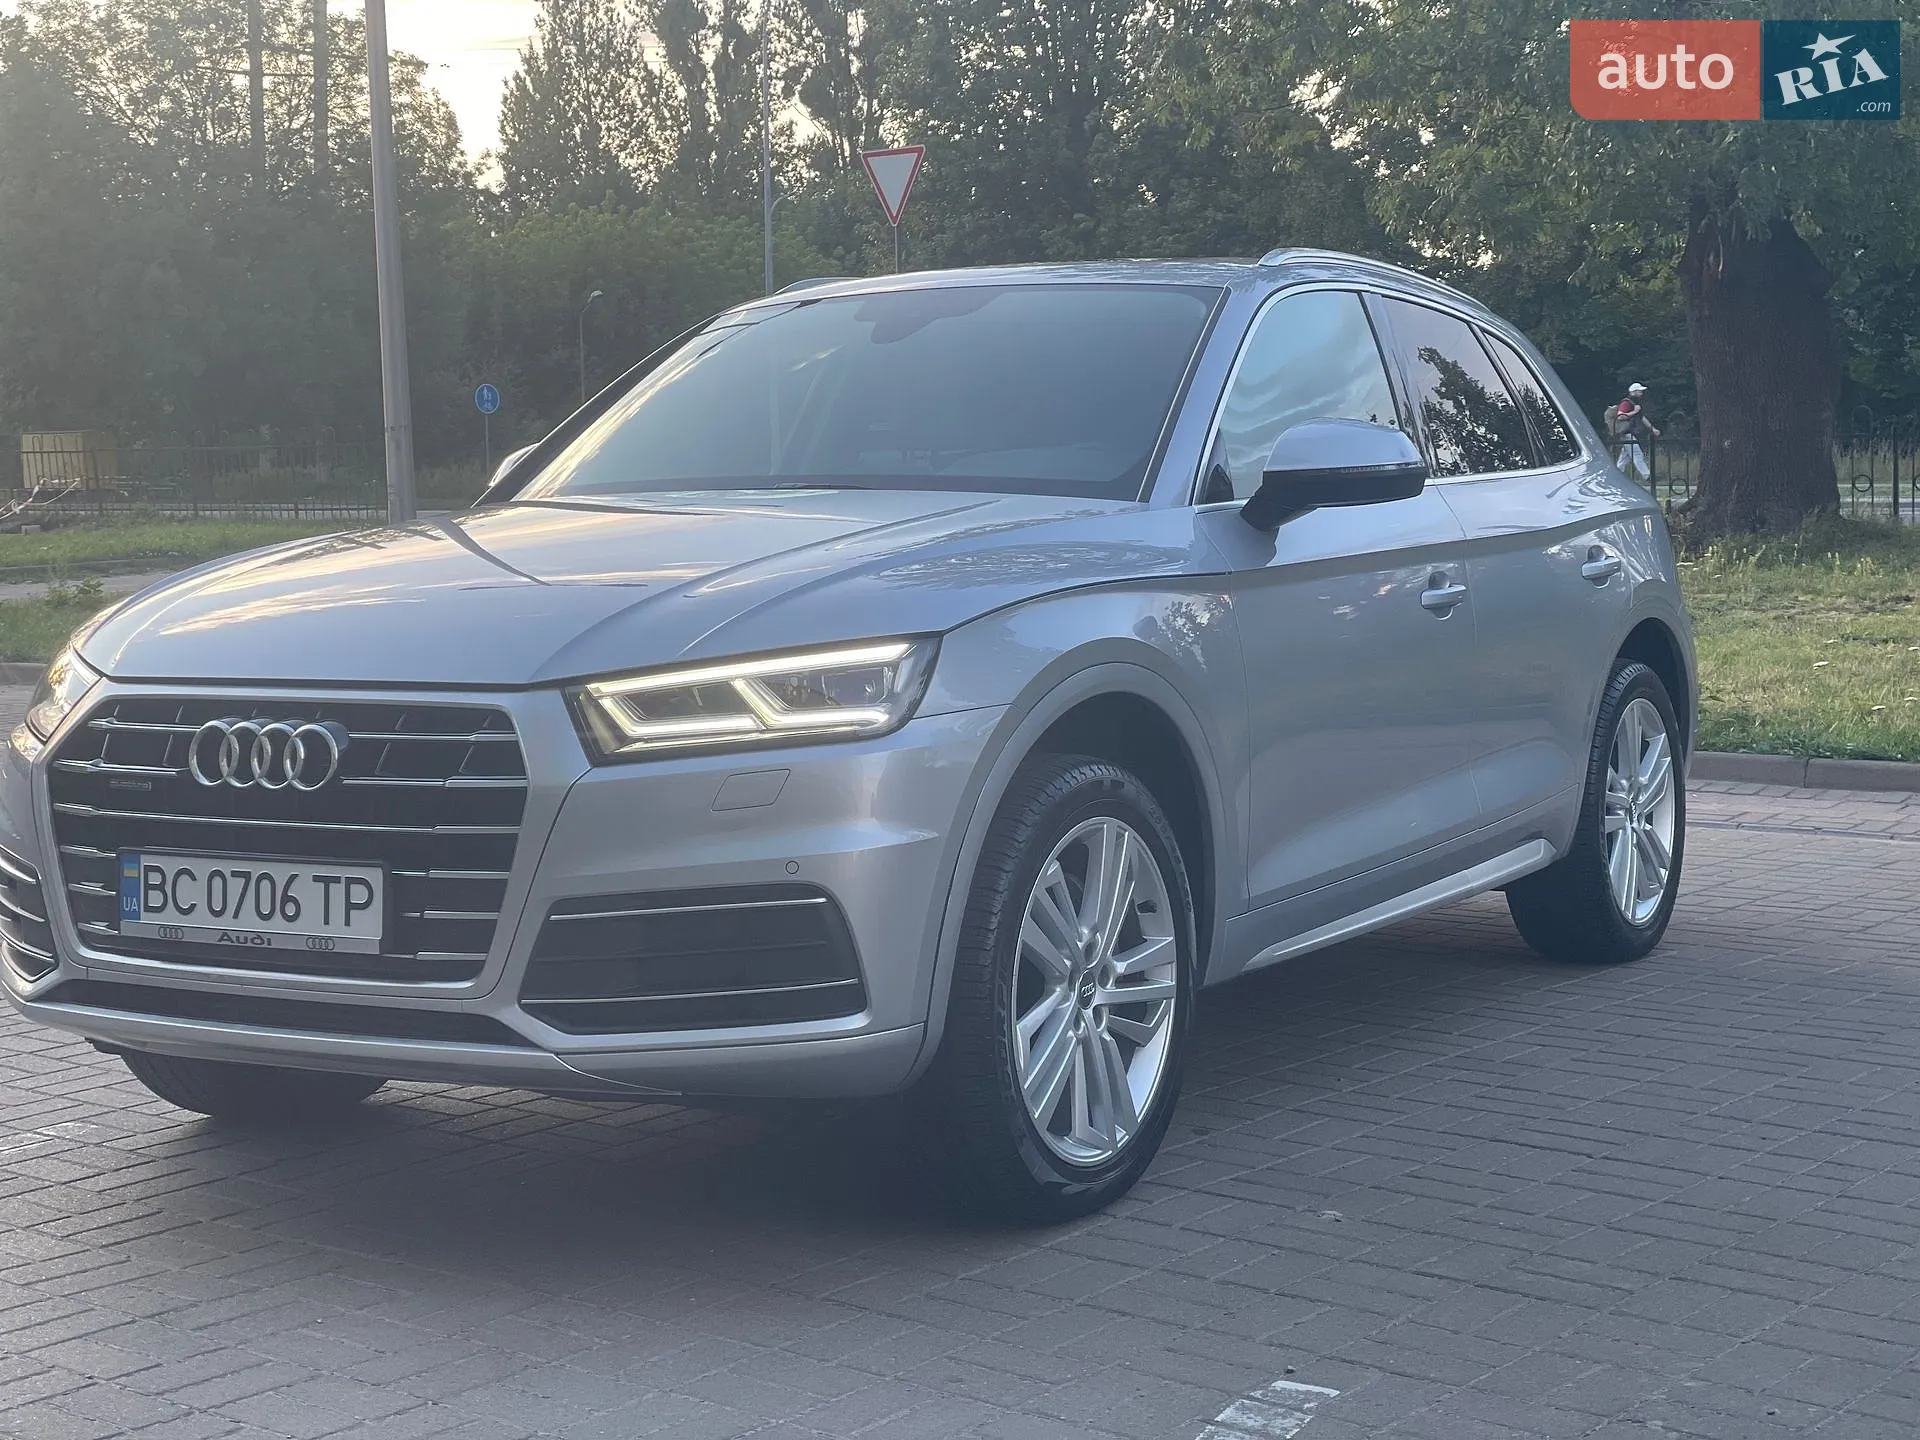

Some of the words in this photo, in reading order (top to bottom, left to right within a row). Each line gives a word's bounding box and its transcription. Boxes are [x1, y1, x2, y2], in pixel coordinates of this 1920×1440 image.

[143, 864, 197, 916] BC
[206, 868, 302, 923] 0706
[311, 874, 375, 927] TP
[122, 896, 139, 913] UA
[216, 931, 273, 947] Audi
